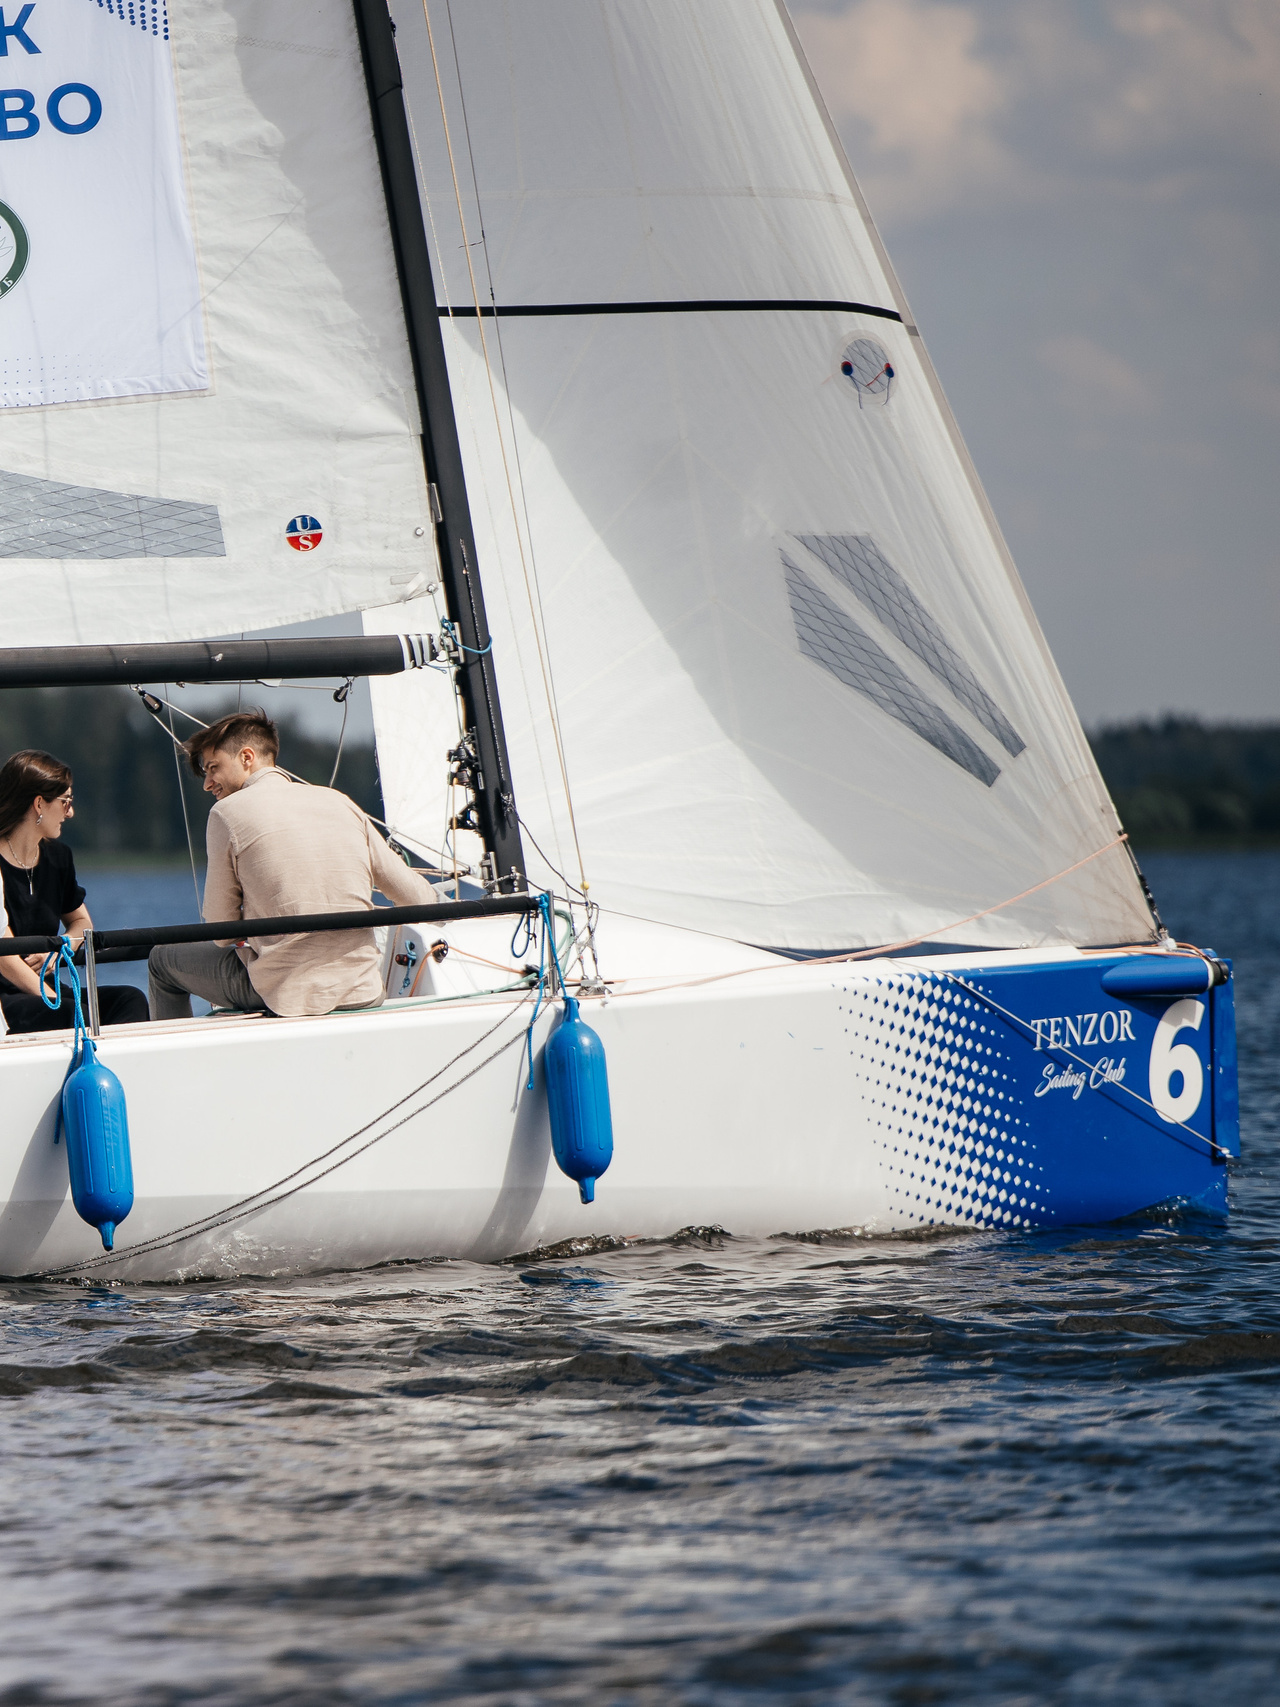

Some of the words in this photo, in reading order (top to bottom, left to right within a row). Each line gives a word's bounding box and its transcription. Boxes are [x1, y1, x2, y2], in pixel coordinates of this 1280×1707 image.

[1030, 1009, 1136, 1051] TENZOR
[1034, 1062, 1087, 1100] Sailing
[1089, 1056, 1127, 1089] Club
[1148, 998, 1206, 1124] 6
